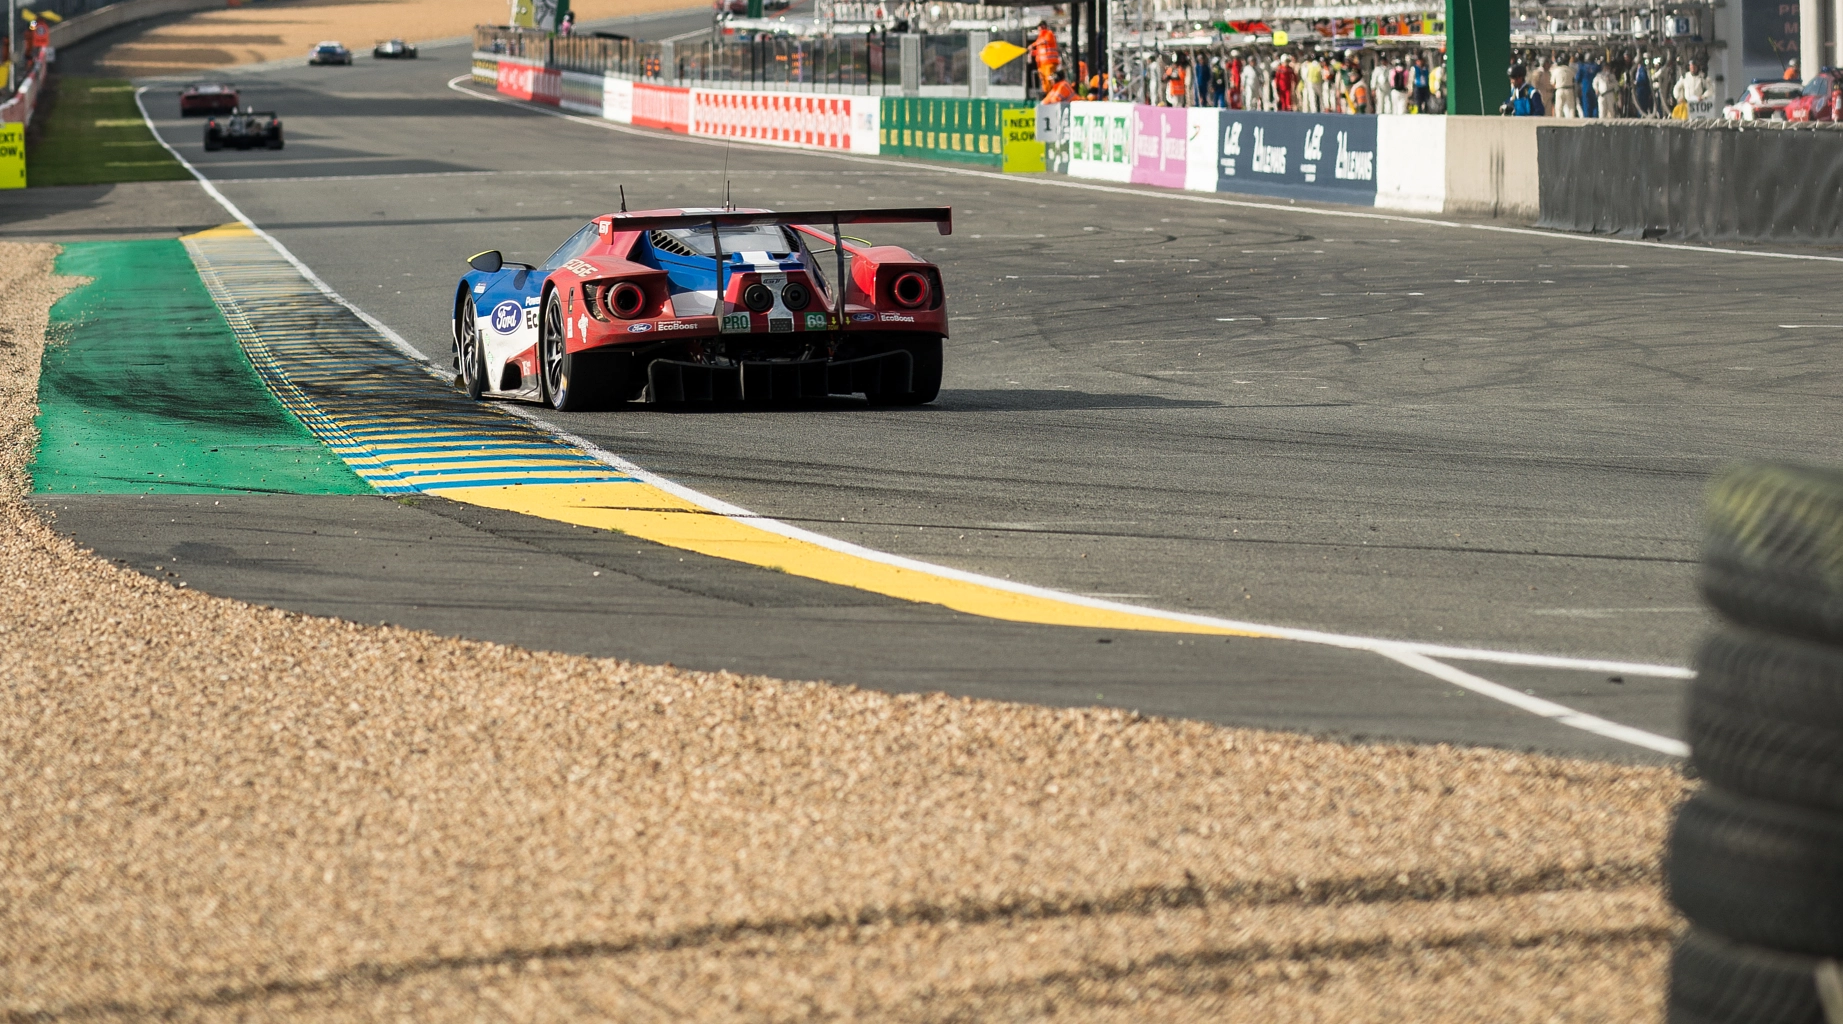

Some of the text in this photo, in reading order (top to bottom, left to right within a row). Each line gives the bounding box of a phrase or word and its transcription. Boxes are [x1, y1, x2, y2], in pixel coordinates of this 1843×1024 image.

[1689, 101, 1713, 112] STOP
[1010, 118, 1036, 128] NEXT
[1009, 131, 1036, 142] SLOW
[599, 220, 612, 235] GT
[563, 259, 599, 277] EDGE
[496, 305, 517, 329] Ford
[723, 315, 749, 330] PRO
[806, 314, 825, 328] 69
[880, 314, 915, 323] EcoBoost
[658, 323, 698, 332] EcoBoost
